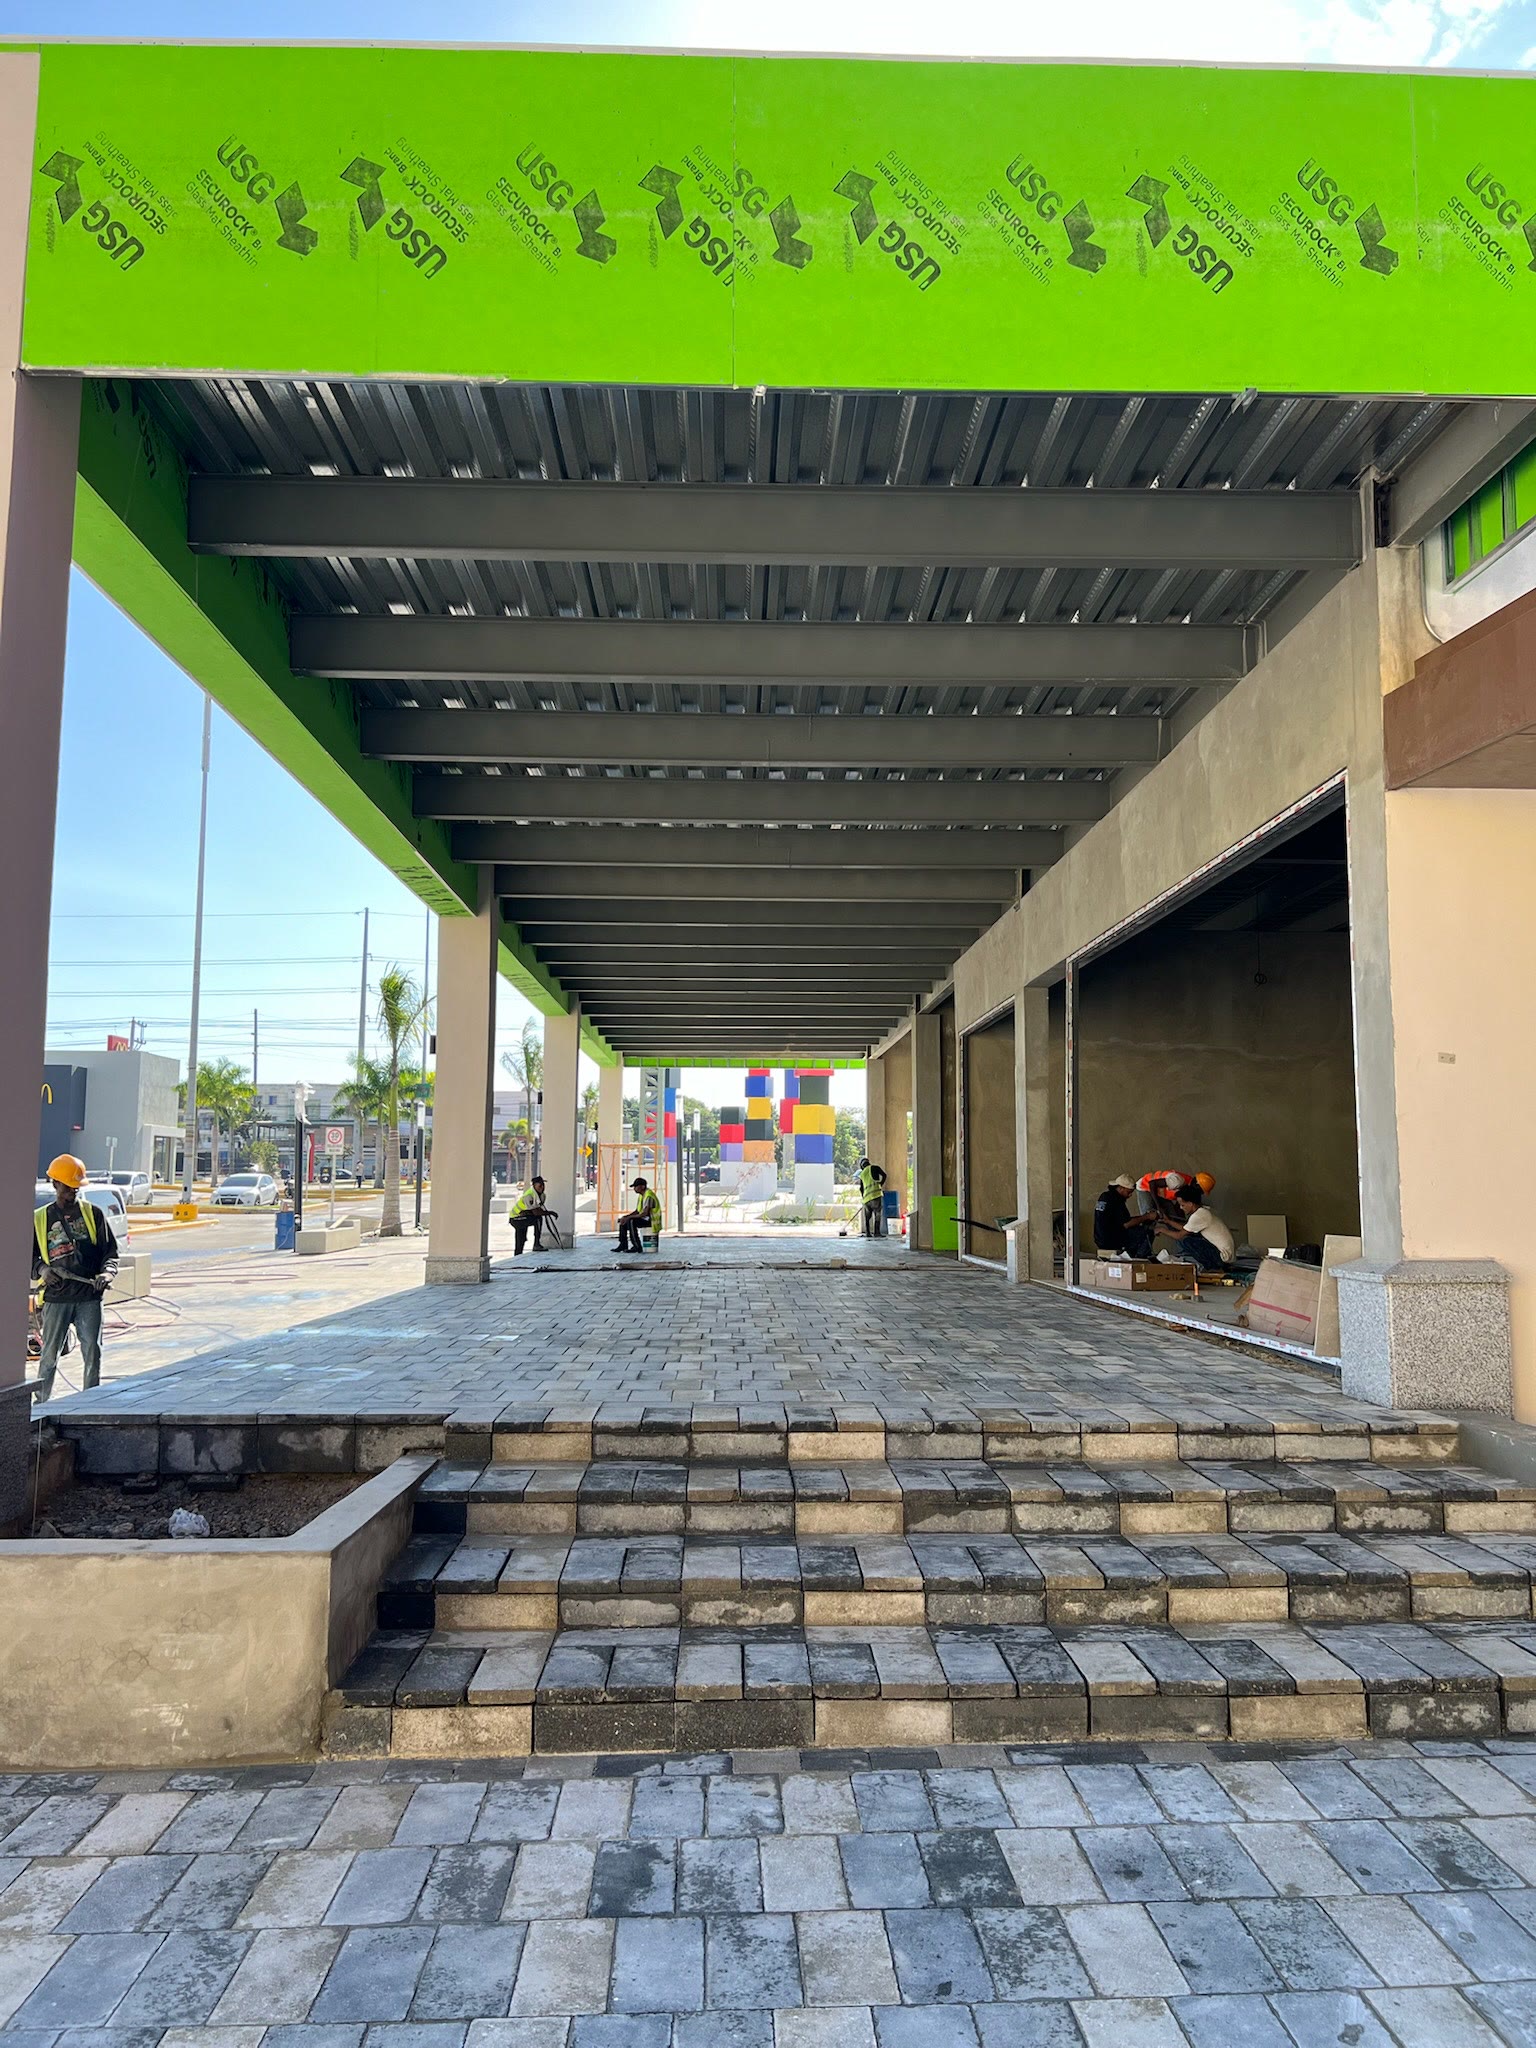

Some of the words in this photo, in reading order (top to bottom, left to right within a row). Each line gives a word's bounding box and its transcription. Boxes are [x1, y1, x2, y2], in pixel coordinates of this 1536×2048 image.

[82, 141, 106, 167] Brand
[217, 133, 276, 205] USG
[384, 147, 407, 174] Brand
[516, 141, 574, 213] USG
[681, 155, 704, 182] Brand
[874, 160, 898, 187] Brand
[1167, 165, 1191, 191] Brand
[139, 177, 159, 198] Mat
[157, 196, 177, 218] lass
[440, 185, 459, 206] Mat
[458, 204, 478, 226] lass
[734, 162, 770, 219] SG
[931, 197, 951, 219] Mat
[1006, 153, 1063, 224] USG
[1223, 200, 1242, 221] Mat
[1297, 158, 1355, 227] USG
[1466, 162, 1522, 231] USG
[82, 200, 145, 271] USG
[186, 181, 207, 208] Glass
[206, 206, 222, 228] Mat
[221, 225, 258, 268] Sheathin
[385, 207, 448, 280] USG
[486, 190, 508, 217] Glass
[506, 214, 523, 235] Mat
[522, 234, 559, 276] Sheathin
[878, 221, 941, 291] USG
[950, 216, 970, 237] lass
[976, 201, 999, 228] Glass
[998, 226, 1015, 247] Mat
[1013, 245, 1051, 287] Sheathin
[1242, 219, 1264, 241] lass
[1269, 205, 1291, 231] Glass
[1290, 229, 1308, 249] Mat
[1306, 247, 1344, 289] Sheathin
[1438, 208, 1460, 235] Glass
[1460, 232, 1476, 253] Mat
[1475, 251, 1514, 293] Sheathin
[1172, 224, 1234, 295] USG
